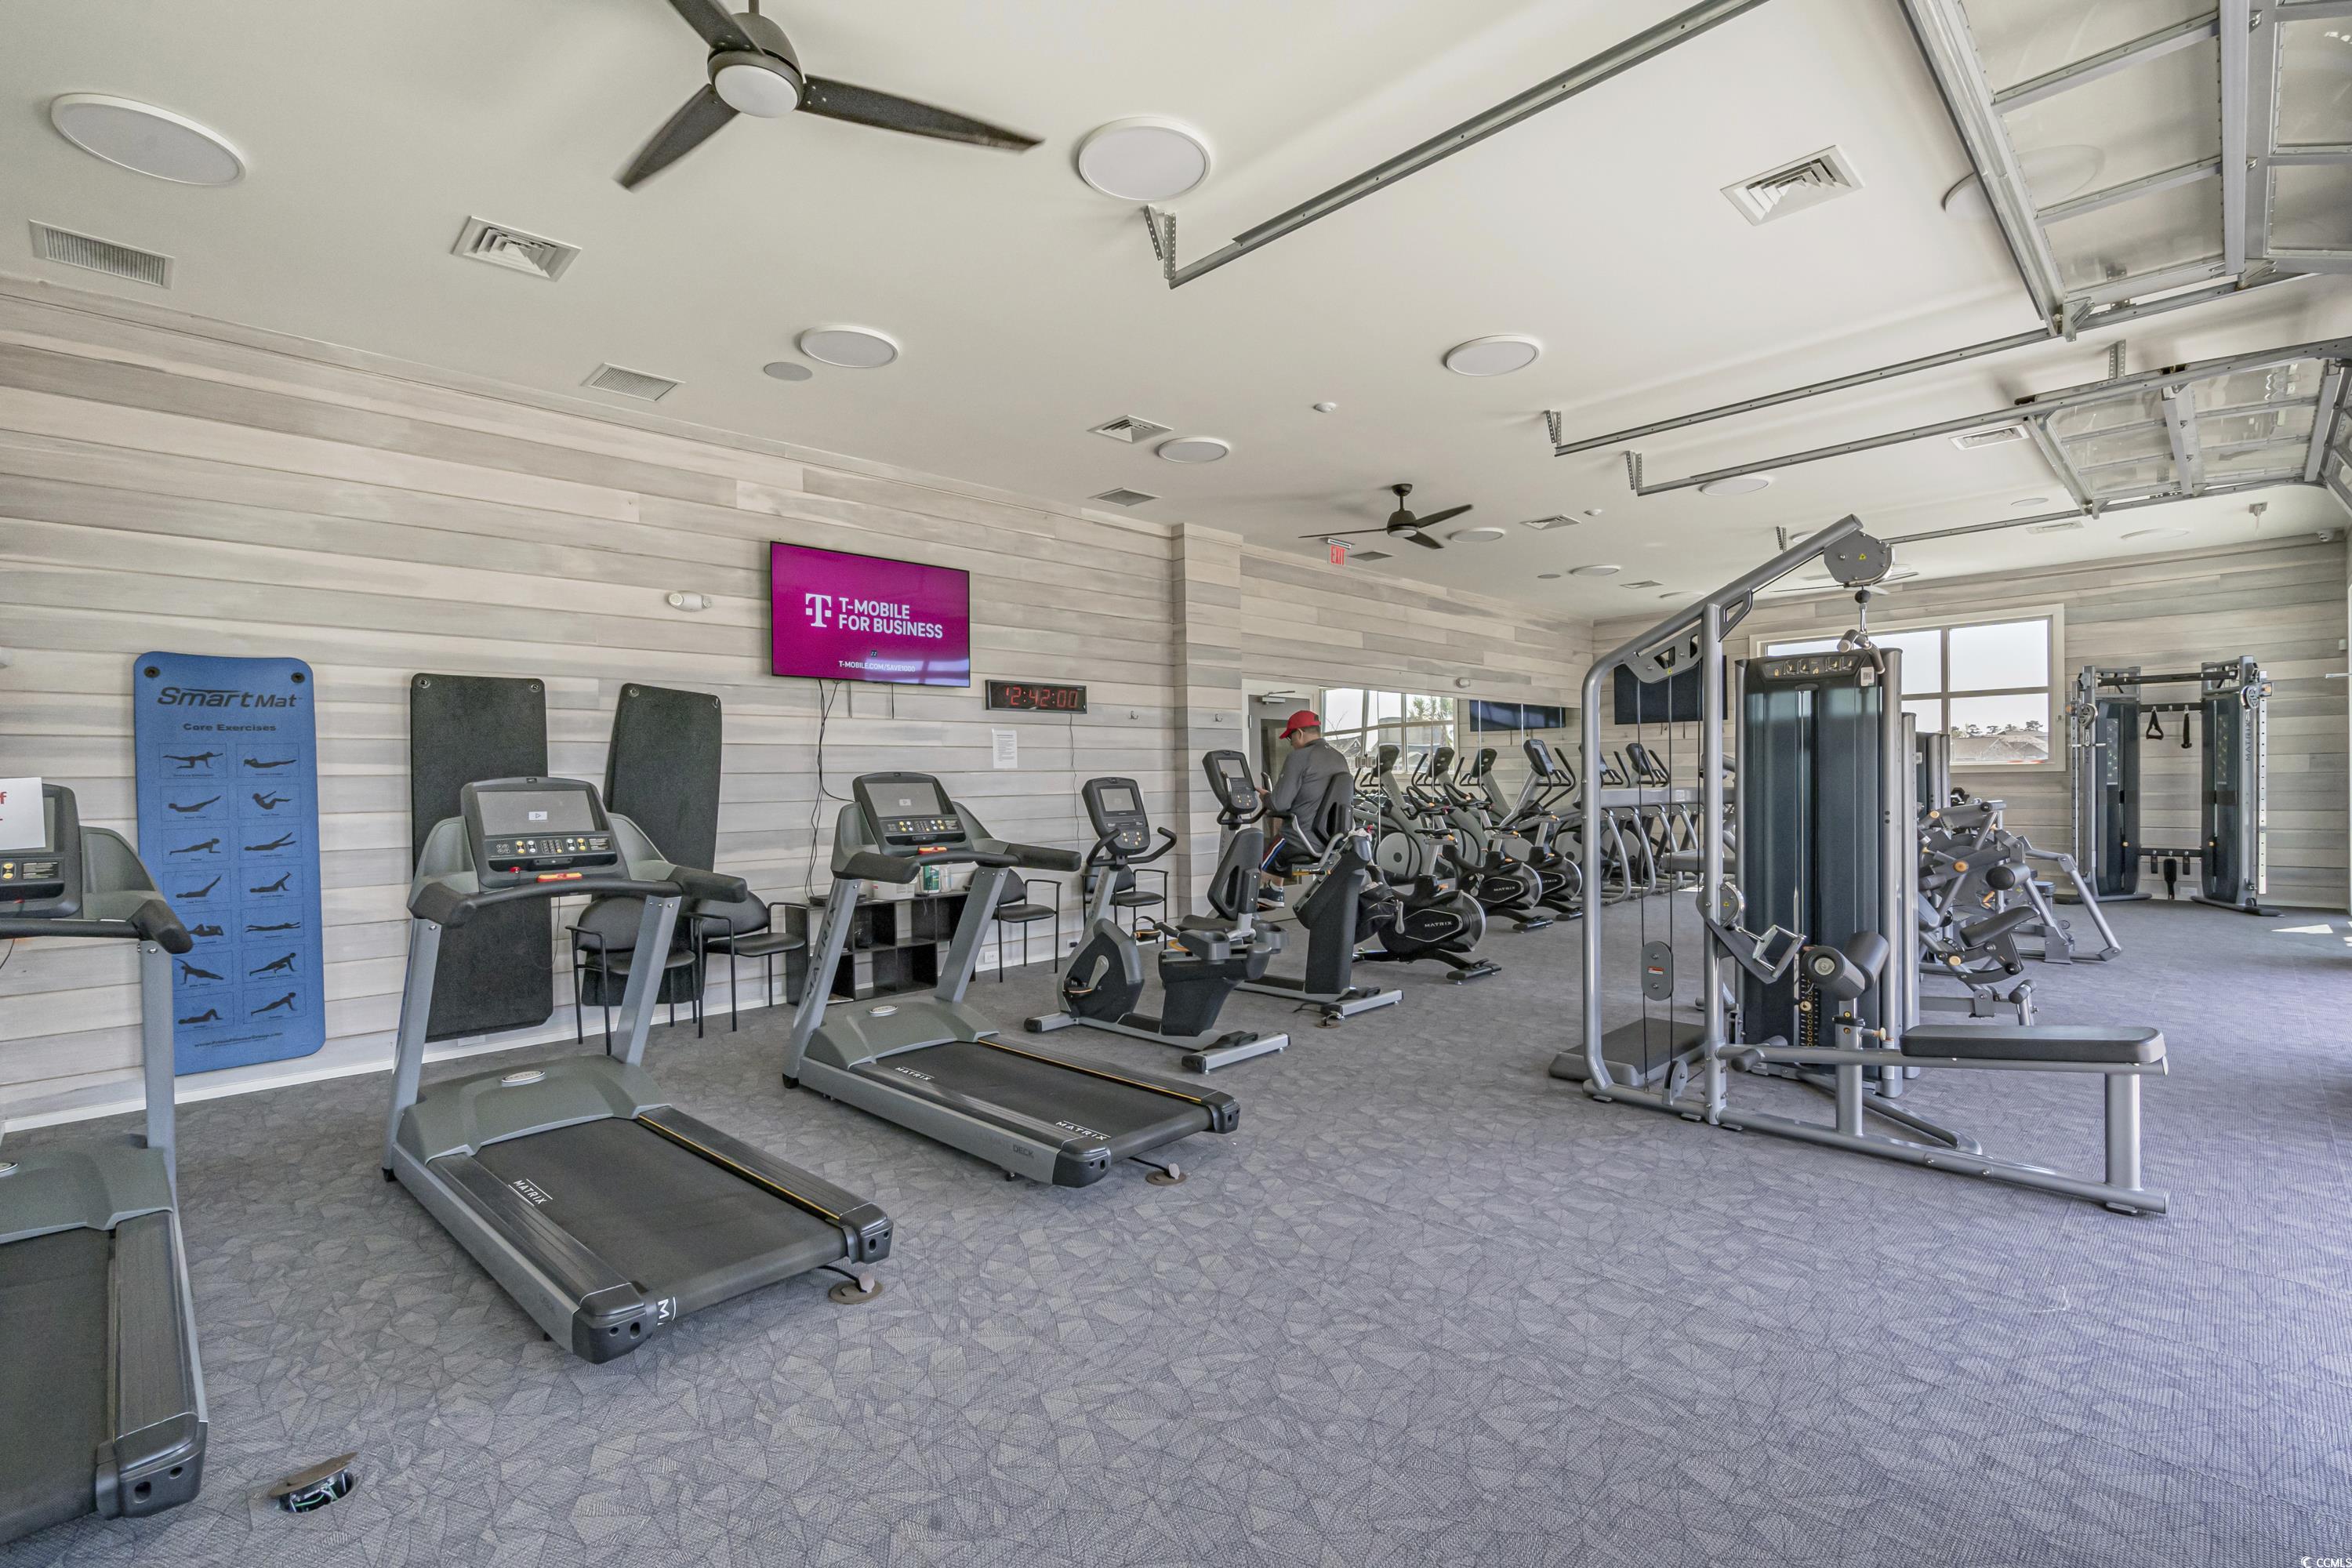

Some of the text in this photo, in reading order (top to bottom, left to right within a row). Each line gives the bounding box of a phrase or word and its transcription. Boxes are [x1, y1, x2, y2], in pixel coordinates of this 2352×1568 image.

[1330, 545, 1345, 565] EXIT
[839, 597, 910, 619] T-MOBILE
[839, 614, 943, 639] FOR BUSINESS
[839, 660, 916, 672] T-MOBILE.COM/SAVE1000
[1005, 687, 1078, 709] 12:42:00
[895, 1067, 931, 1081] MATRIX
[1055, 1121, 1108, 1141] MATRIX
[513, 1180, 547, 1204] MATRIX
